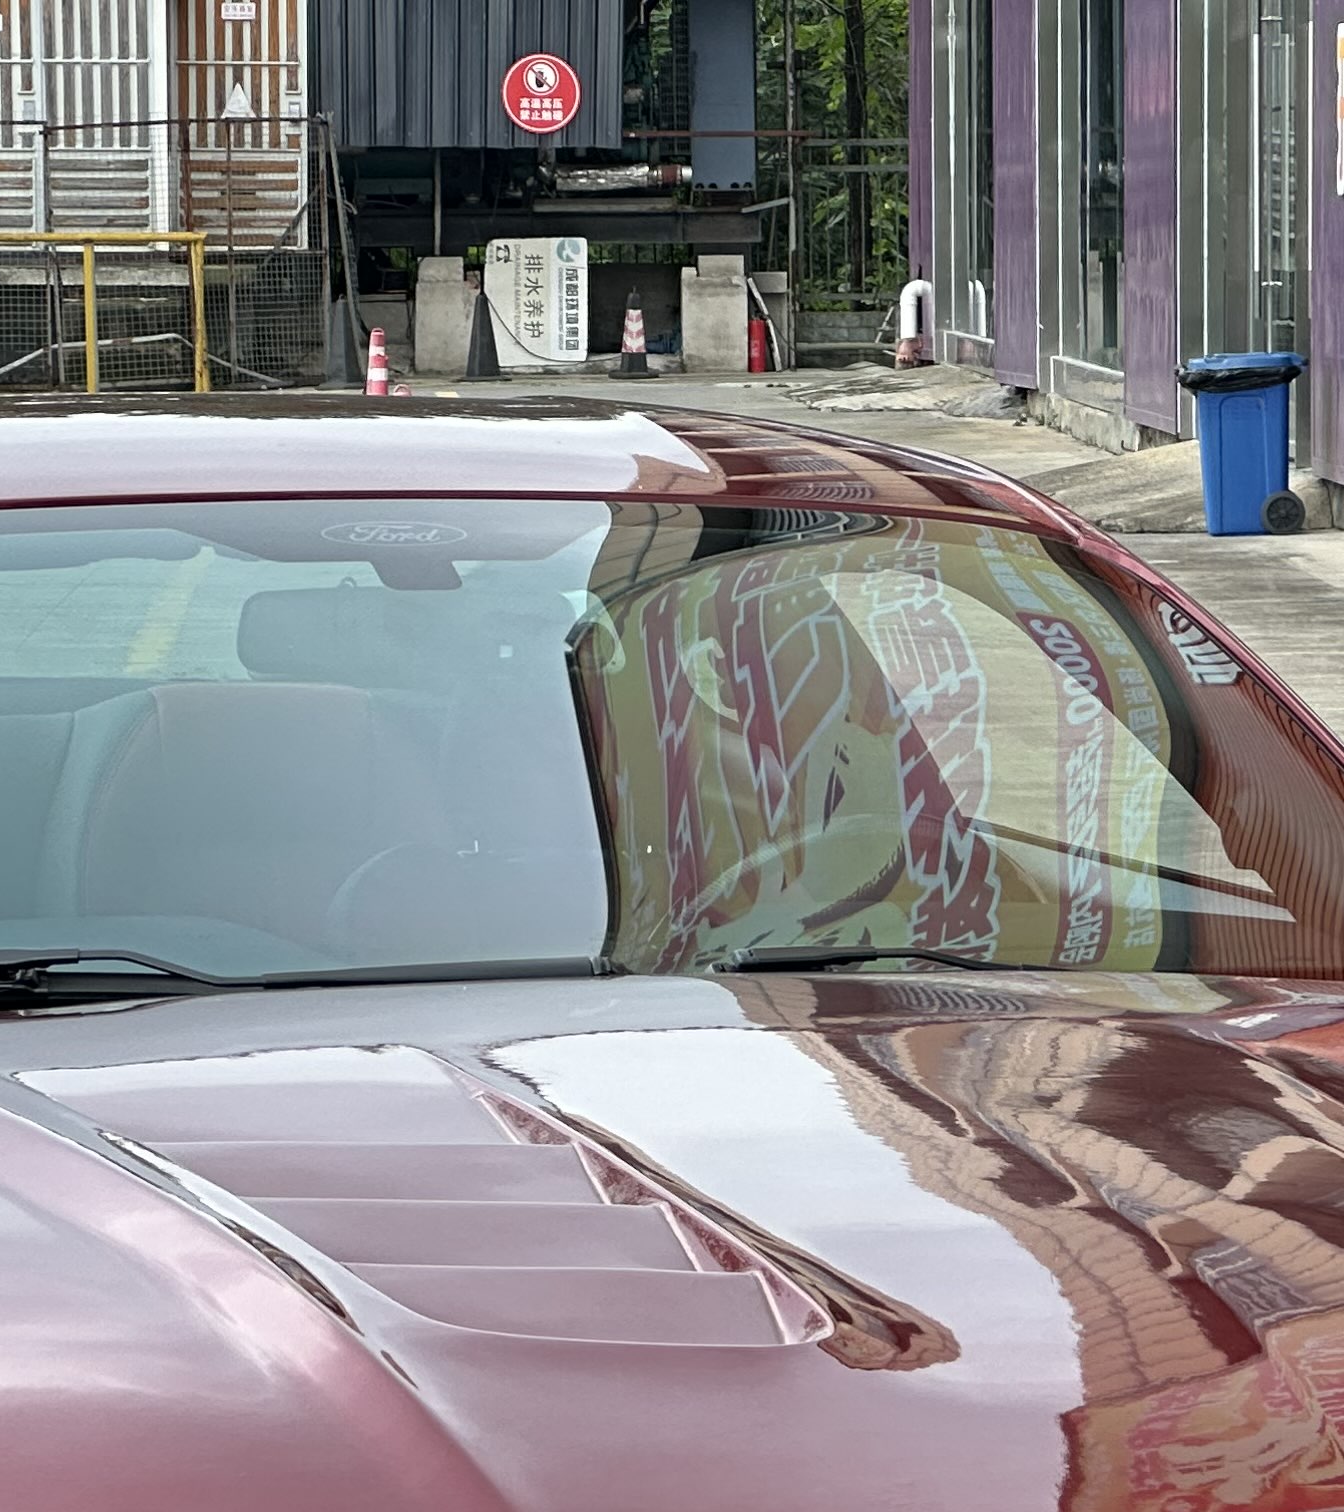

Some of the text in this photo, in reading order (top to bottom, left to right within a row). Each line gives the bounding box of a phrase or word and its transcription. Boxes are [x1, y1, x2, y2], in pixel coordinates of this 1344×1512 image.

[524, 253, 545, 339] 排水养护
[349, 524, 441, 543] Ford
